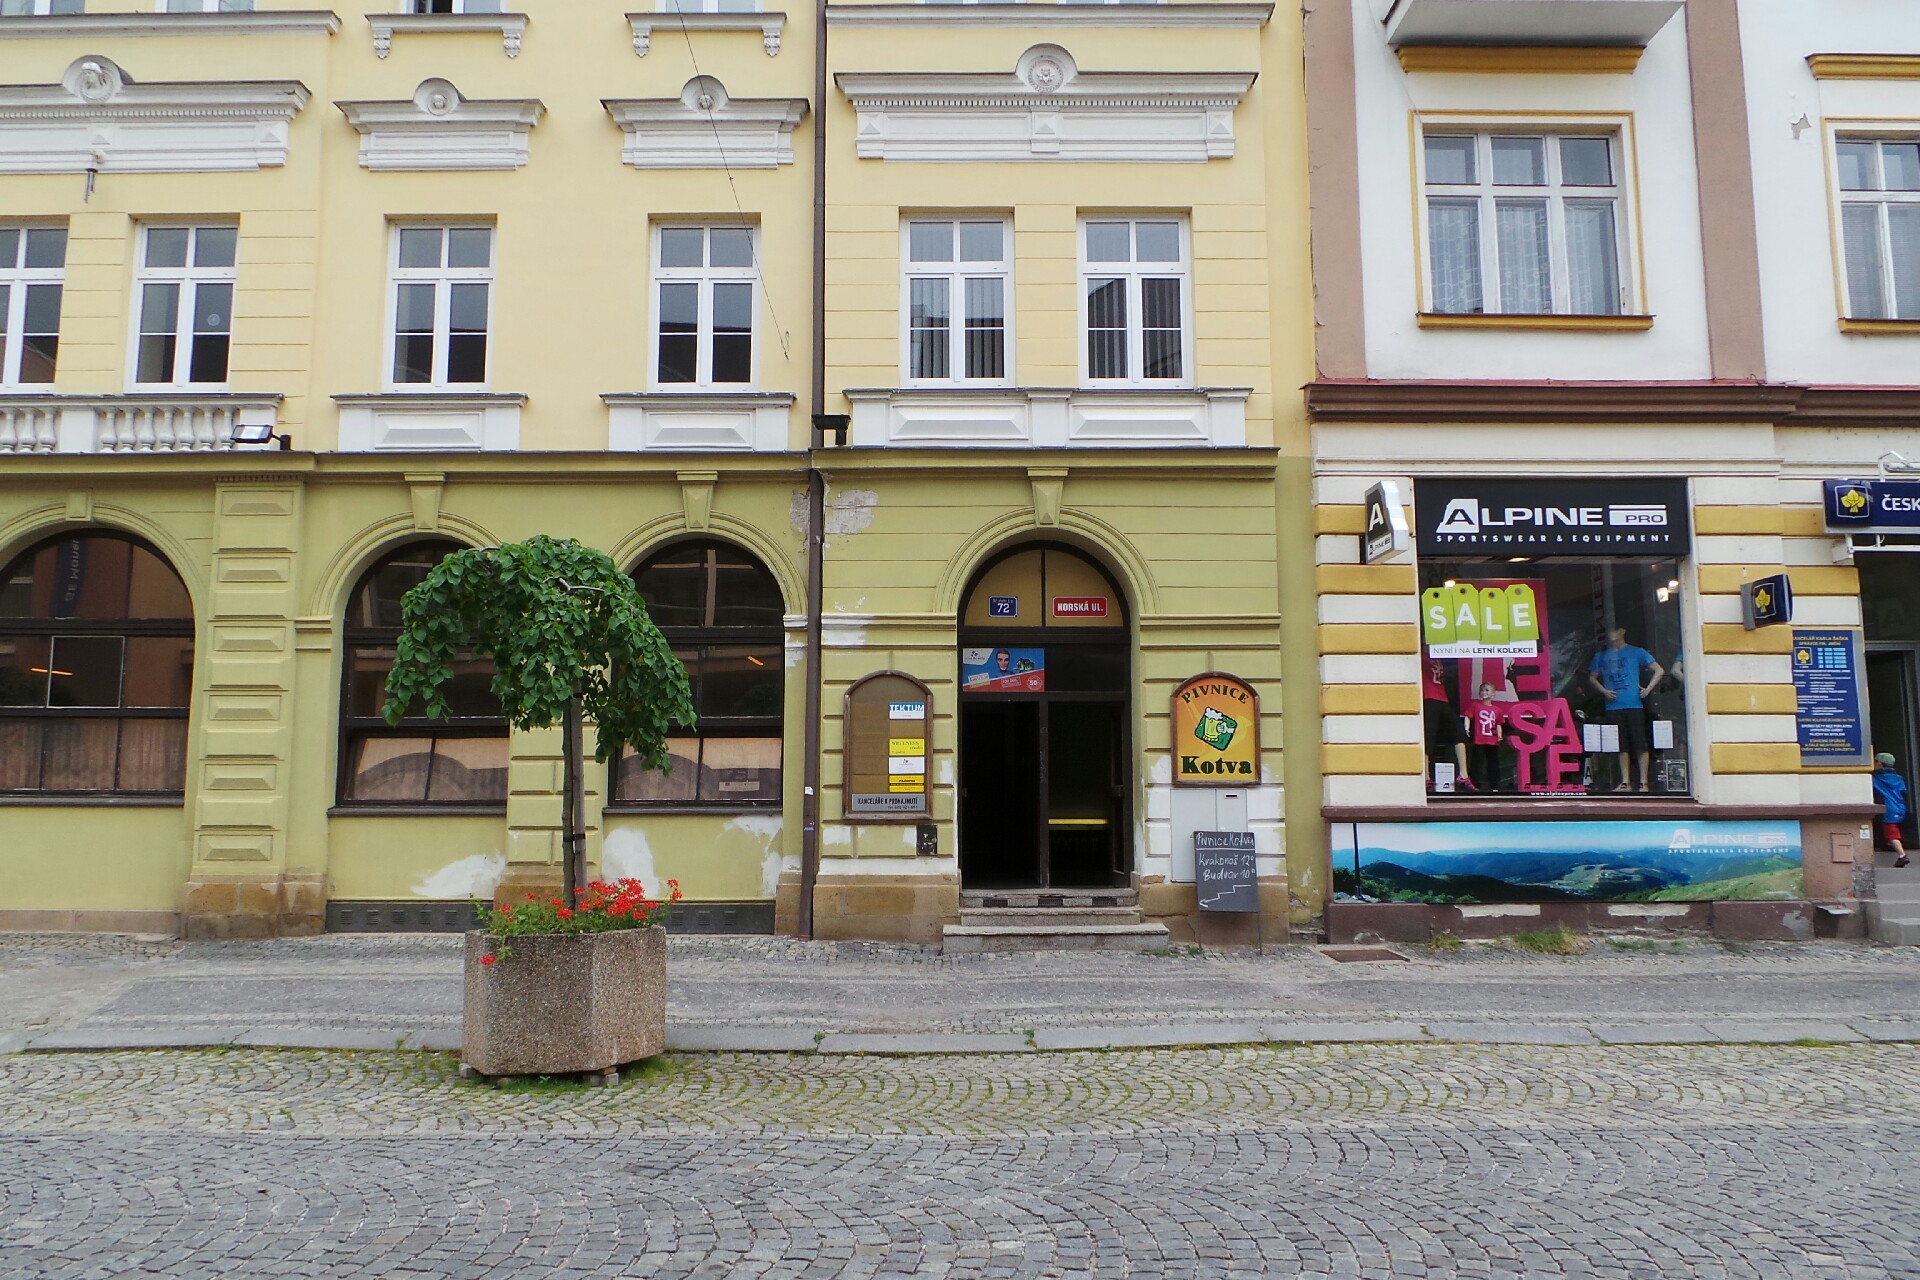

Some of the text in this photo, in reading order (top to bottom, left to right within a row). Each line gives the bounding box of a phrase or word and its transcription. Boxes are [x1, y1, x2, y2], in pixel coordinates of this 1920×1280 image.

[1436, 498, 1664, 533] ALPINE PRO
[1436, 534, 1670, 543] SPORTSWEAR & EQUIPMENT
[996, 602, 1010, 613] 72
[1057, 601, 1104, 612] HORSKÁ UL.
[1429, 603, 1531, 630] SALE
[1433, 646, 1453, 654] NYNÍ
[1472, 646, 1495, 654] LETNÍ
[1181, 684, 1249, 704] PIVNICE
[889, 704, 924, 712] TEKTUM
[1181, 755, 1252, 774] Kotva
[857, 796, 884, 805] KANCELÁŘE
[884, 797, 888, 805] K
[1668, 828, 1758, 849] ALPINE
[1199, 853, 1238, 866] Krakonoš
[1203, 868, 1239, 881] Budvar
